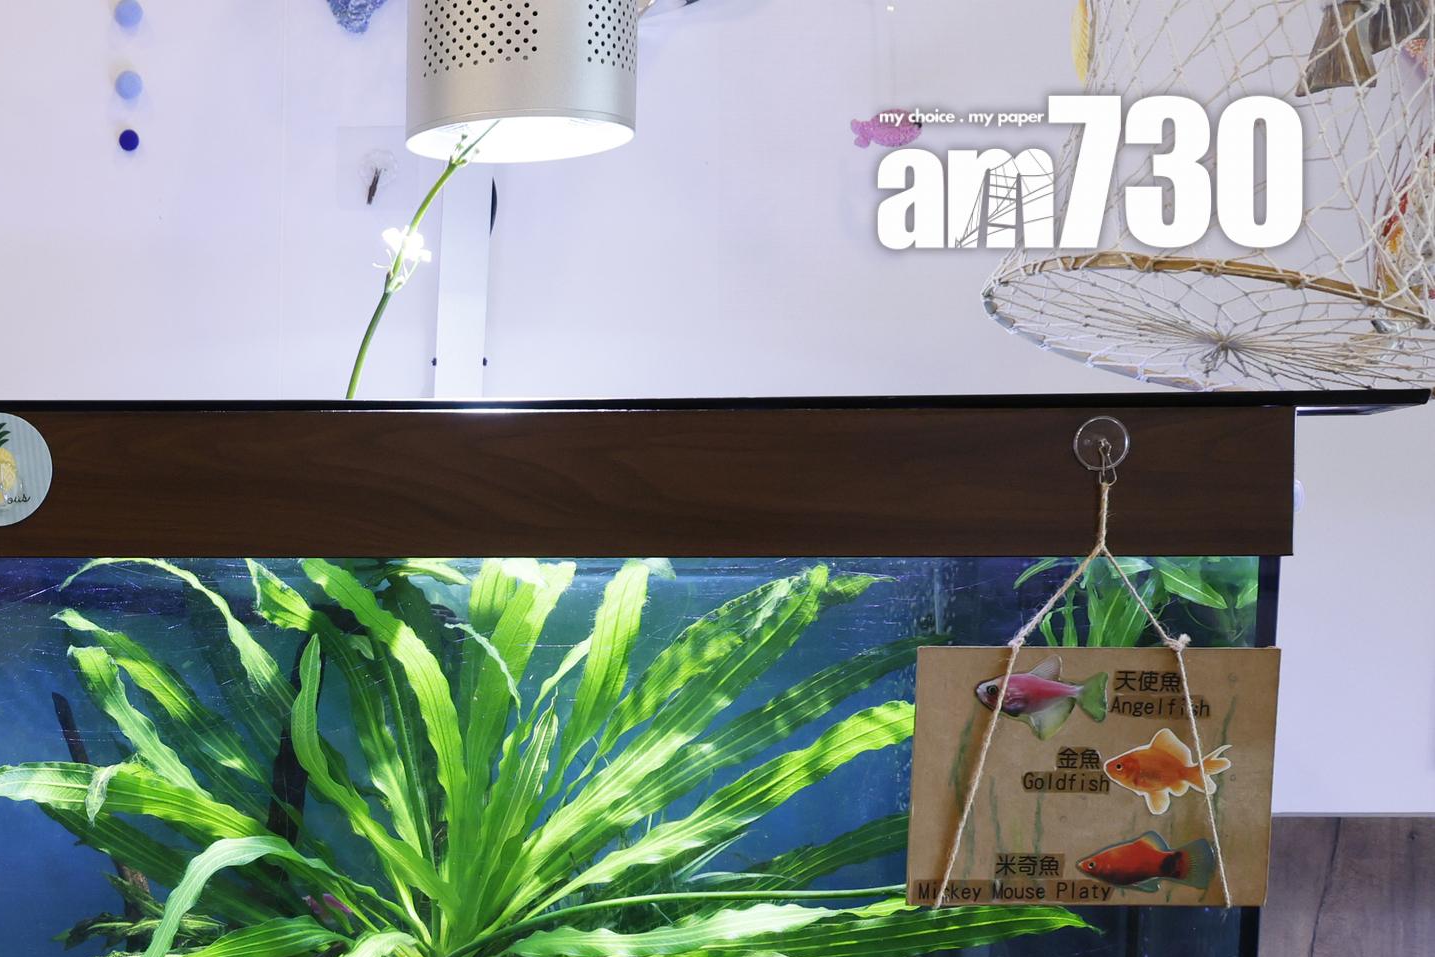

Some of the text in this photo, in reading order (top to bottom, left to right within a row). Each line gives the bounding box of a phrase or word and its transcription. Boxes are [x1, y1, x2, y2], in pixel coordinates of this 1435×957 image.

[1114, 671, 1182, 692] 天使魚
[1057, 748, 1100, 769] 金魚
[1023, 772, 1110, 792] Goldfish
[996, 855, 1060, 876] 米奇魚
[993, 883, 1046, 900] Mouse
[1056, 882, 1112, 901] Platy
